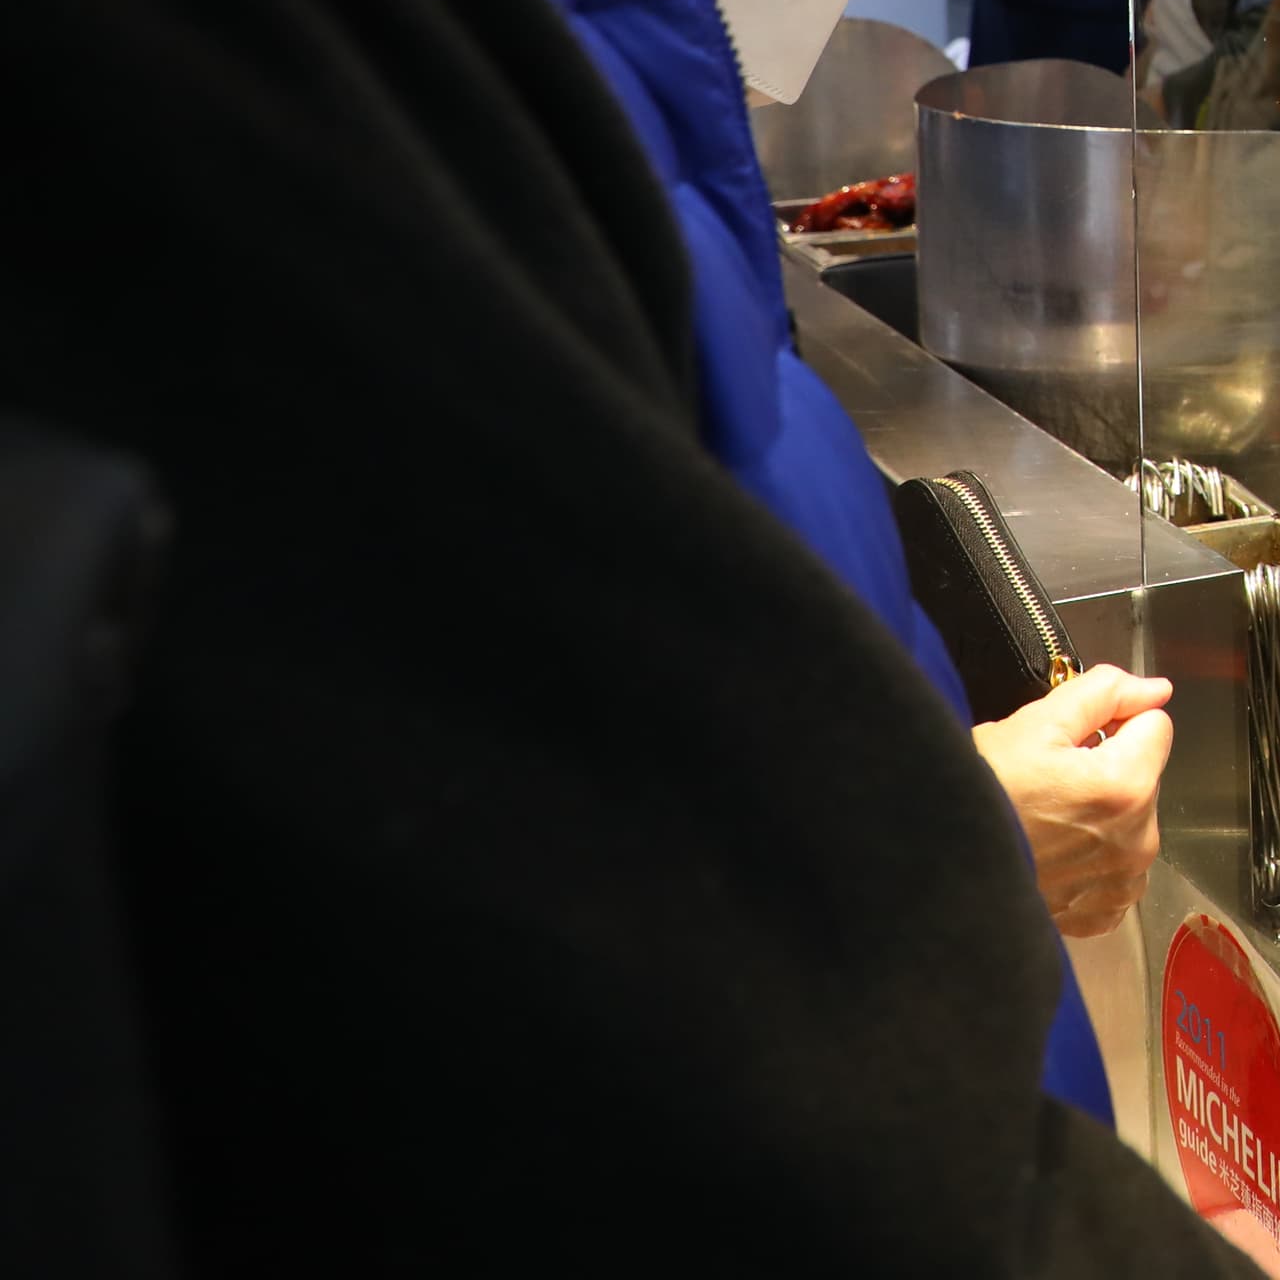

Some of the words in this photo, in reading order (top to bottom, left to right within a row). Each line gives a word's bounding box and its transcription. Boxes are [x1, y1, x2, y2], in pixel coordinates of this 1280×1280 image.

[1175, 990, 1225, 1071] 2011
[1176, 1031, 1221, 1088] Recommended
[1220, 1077, 1229, 1097] in
[1229, 1085, 1241, 1108] the
[1179, 1117, 1218, 1174] guide
